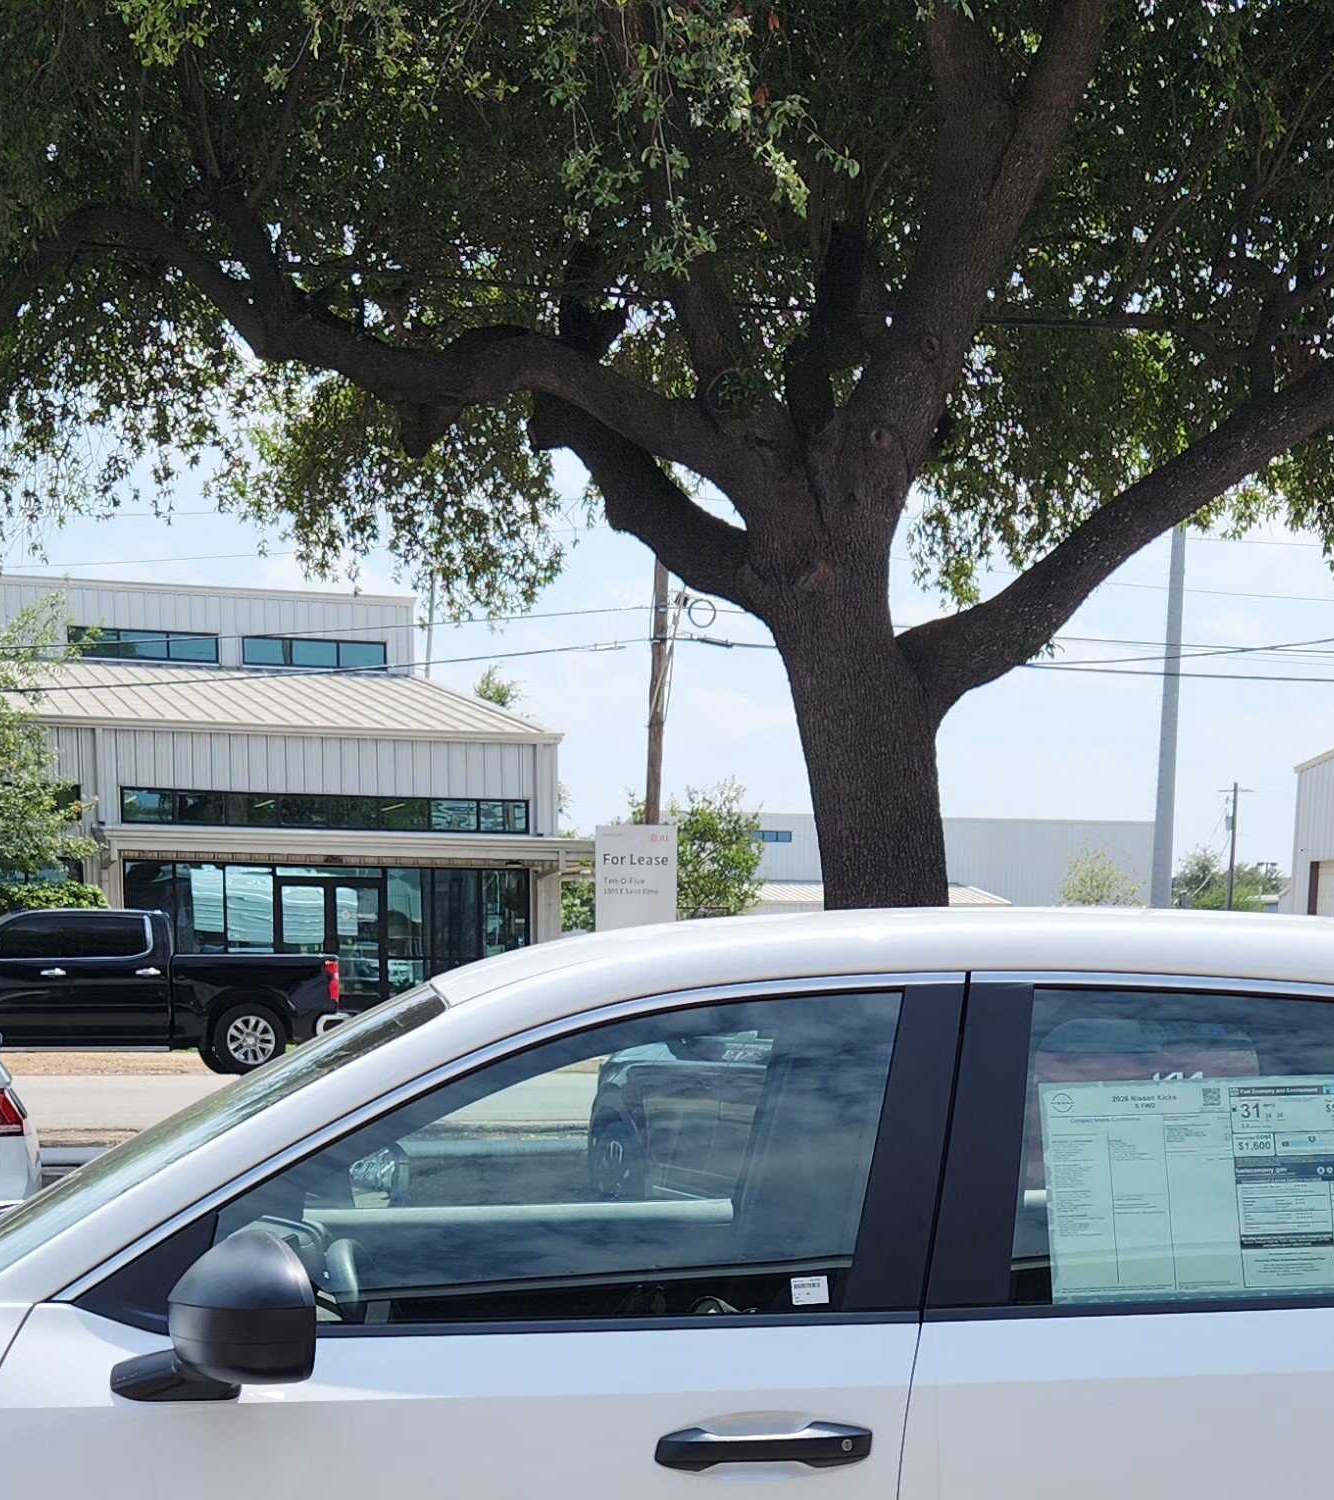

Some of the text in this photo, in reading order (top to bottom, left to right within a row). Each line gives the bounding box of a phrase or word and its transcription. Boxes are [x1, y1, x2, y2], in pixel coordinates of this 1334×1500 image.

[603, 853, 669, 867] For Lease
[1240, 1102, 1260, 1119] 31
[1238, 1140, 1271, 1151] $1,600
